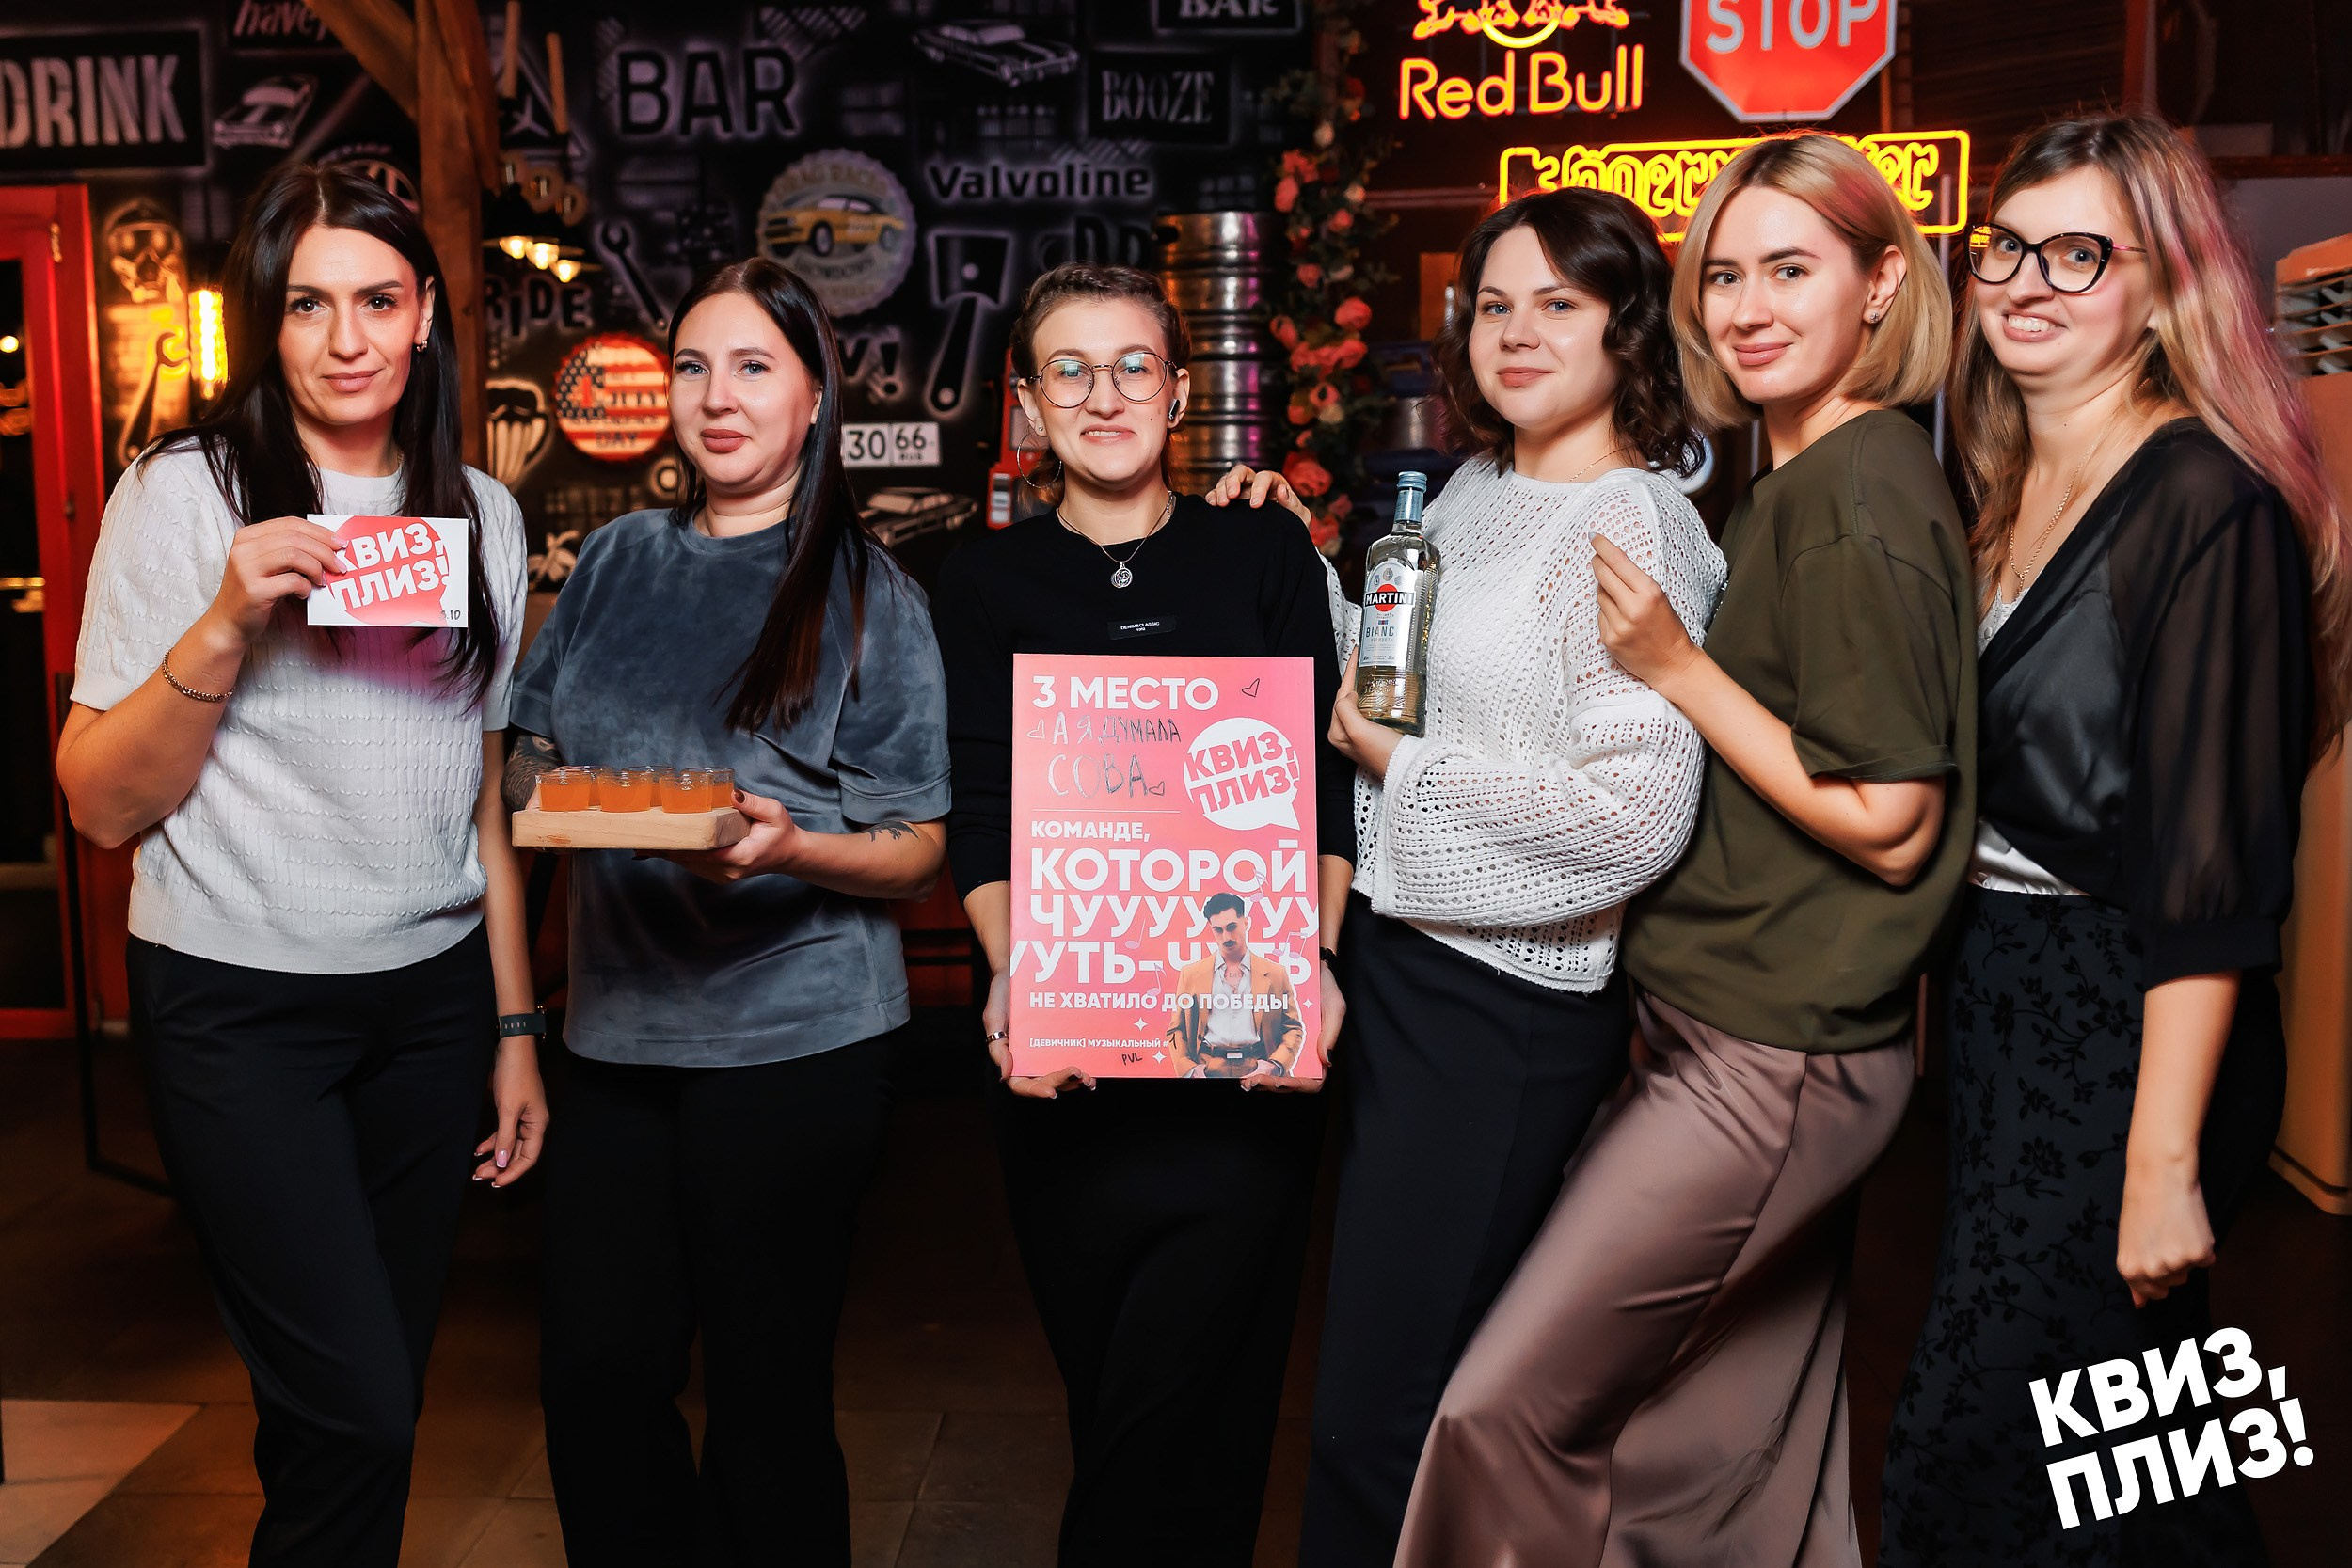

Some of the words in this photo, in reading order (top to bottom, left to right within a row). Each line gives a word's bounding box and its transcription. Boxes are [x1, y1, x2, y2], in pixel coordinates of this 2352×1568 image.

[0, 54, 187, 149] DRINK
[618, 48, 798, 135] BAR
[1101, 70, 1216, 124] BOOZE
[1399, 49, 1517, 120] Red
[1528, 43, 1645, 116] Bull
[929, 161, 1150, 199] Valvoline
[1365, 592, 1414, 606] MARTINI
[1031, 675, 1057, 708] 3
[1070, 676, 1220, 711] МЕСТО
[1047, 752, 1148, 799] СОВА
[1186, 731, 1295, 782] КВИЗ,
[1189, 761, 1300, 815] ПЛИЗ!
[1031, 820, 1151, 843] КОМАНДЕ,
[1030, 839, 1308, 893] КОТОРОЙ
[1029, 992, 1055, 1008] НЕ
[1059, 992, 1158, 1009] ХВАТИЛО
[1162, 993, 1195, 1012] ДО
[1199, 993, 1288, 1013] ПОБЕДЫ
[1029, 1037, 1086, 1048] [ДЕВИЧНИК]
[1087, 1037, 1161, 1048] МУЗЫКАЛЬНЫЙ
